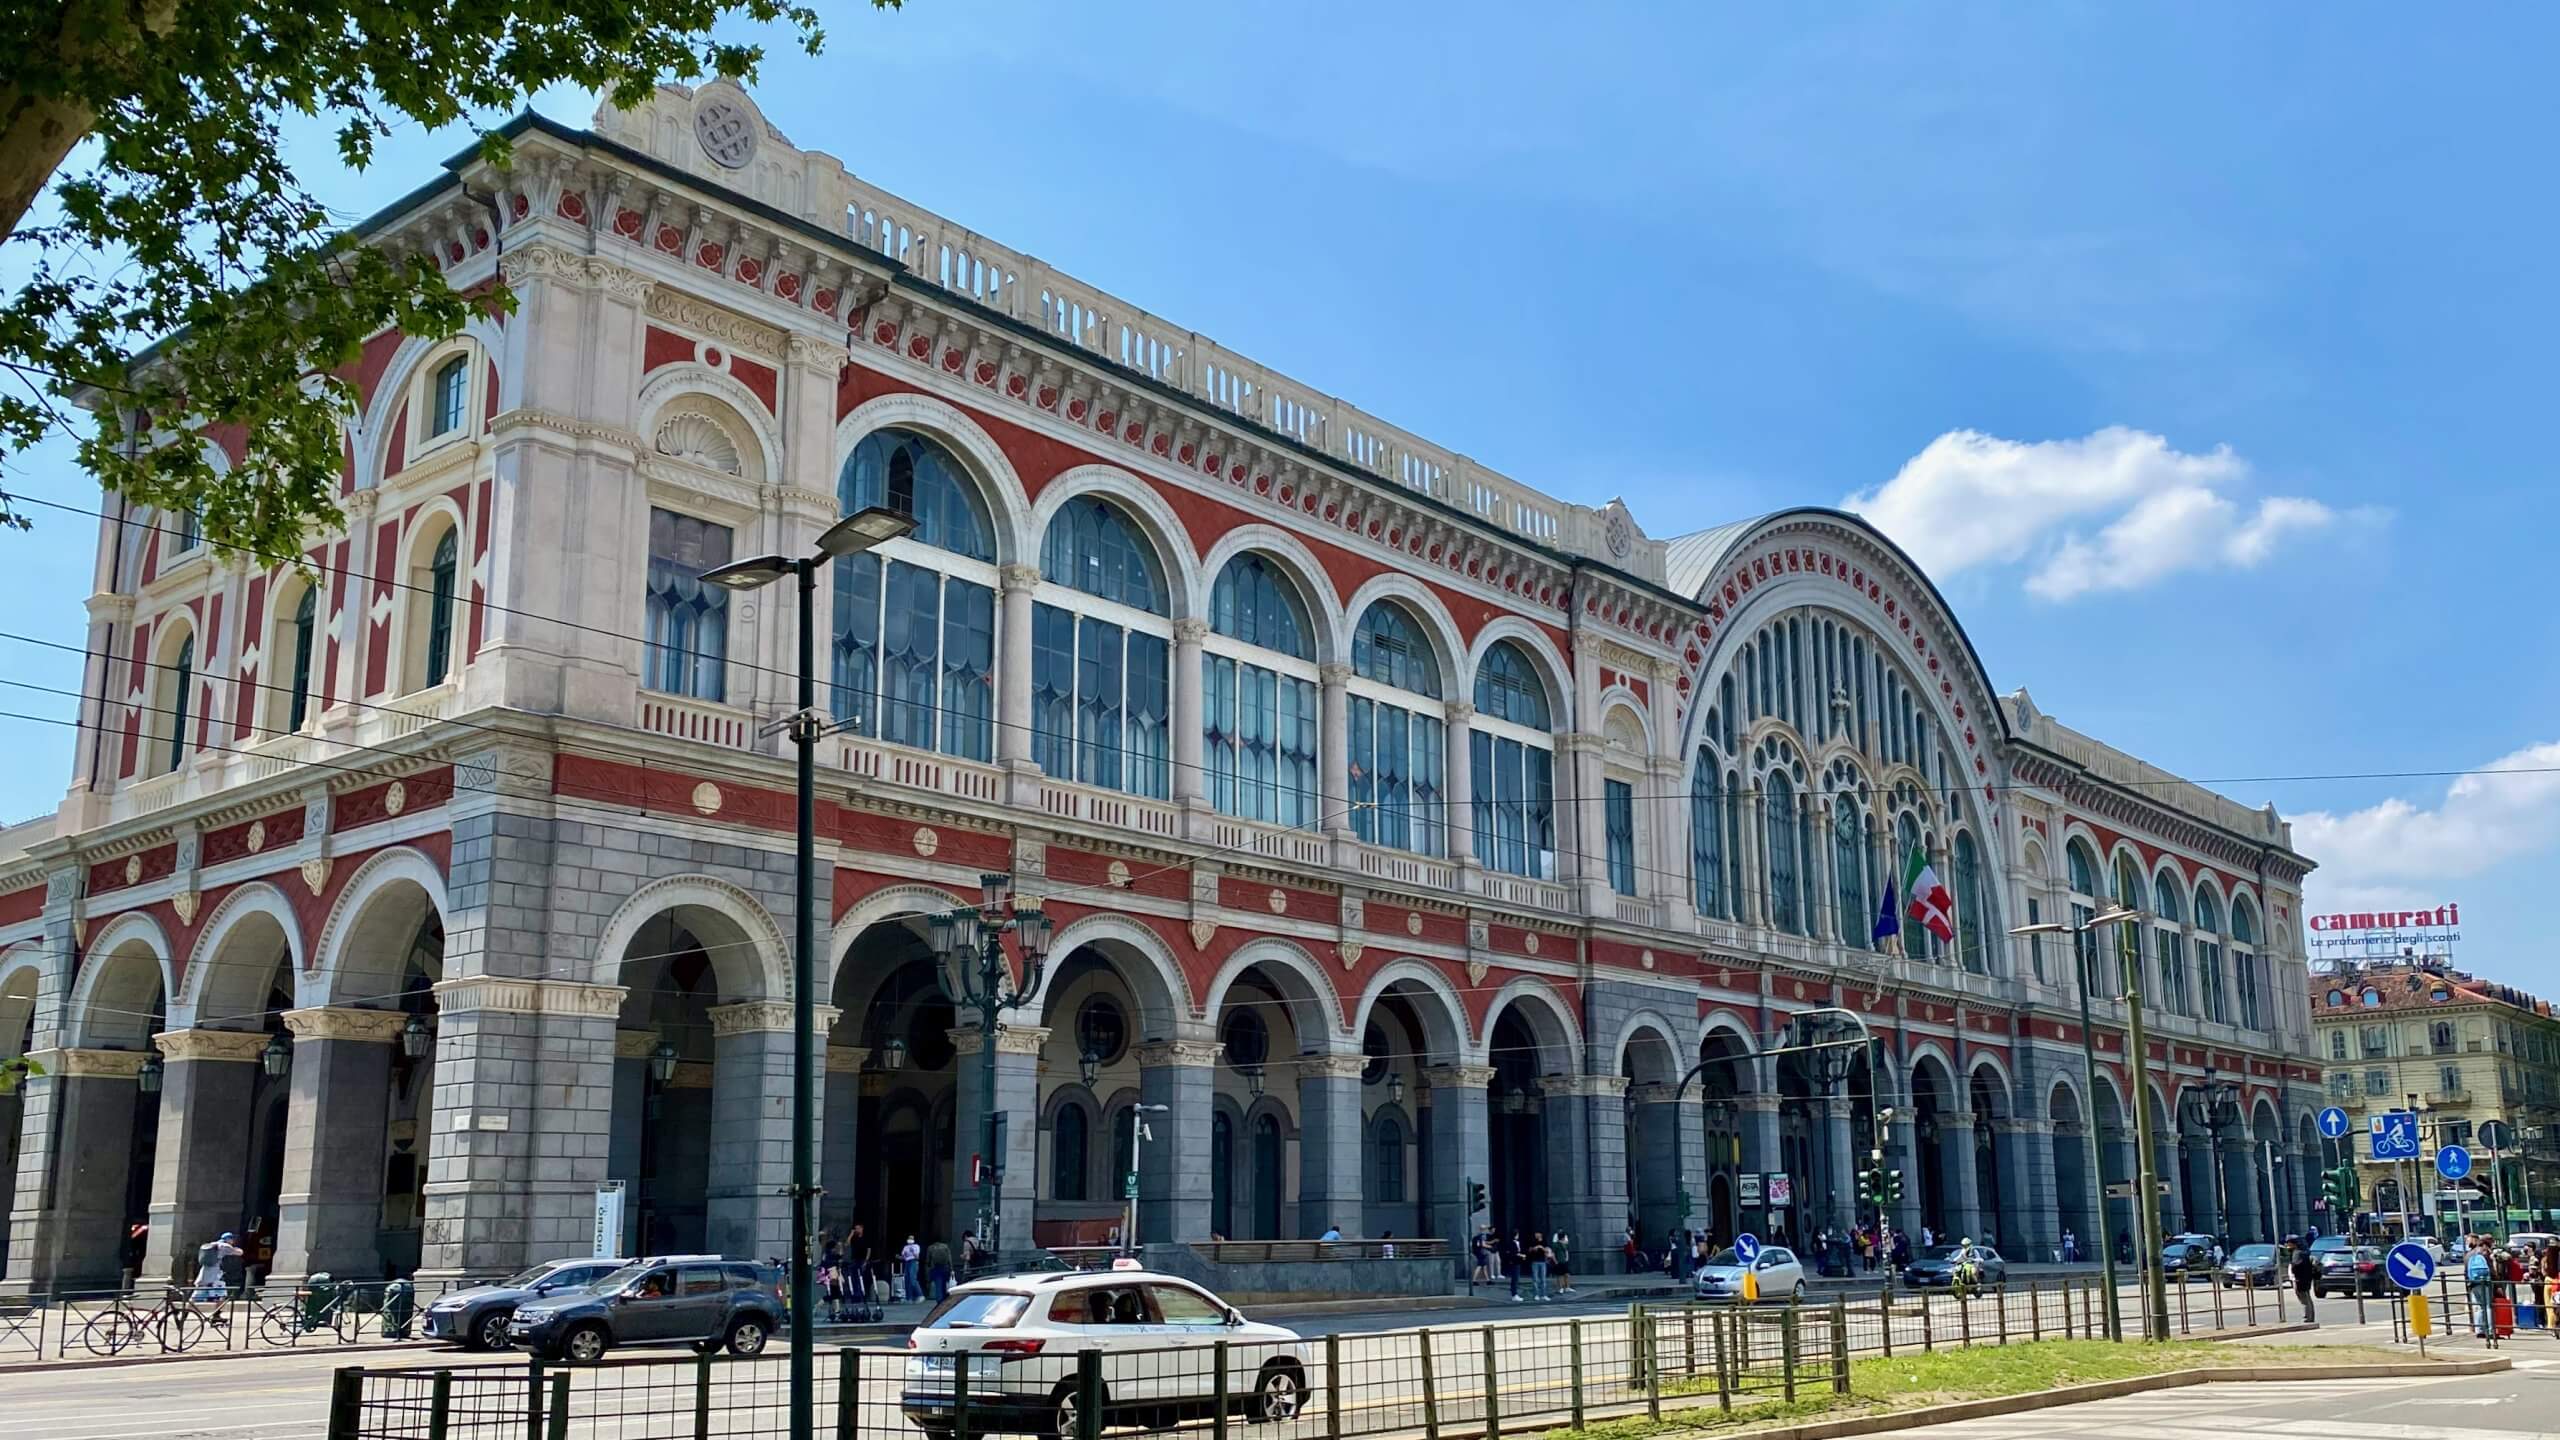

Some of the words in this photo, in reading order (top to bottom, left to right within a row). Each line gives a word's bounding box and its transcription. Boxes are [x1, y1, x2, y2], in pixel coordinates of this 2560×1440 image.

[2310, 902, 2458, 931] camurati
[2311, 936, 2323, 947] Le
[2327, 934, 2391, 948] profumerie
[2395, 931, 2423, 946] degli
[2426, 931, 2461, 943] sconti
[2314, 1200, 2326, 1210] M
